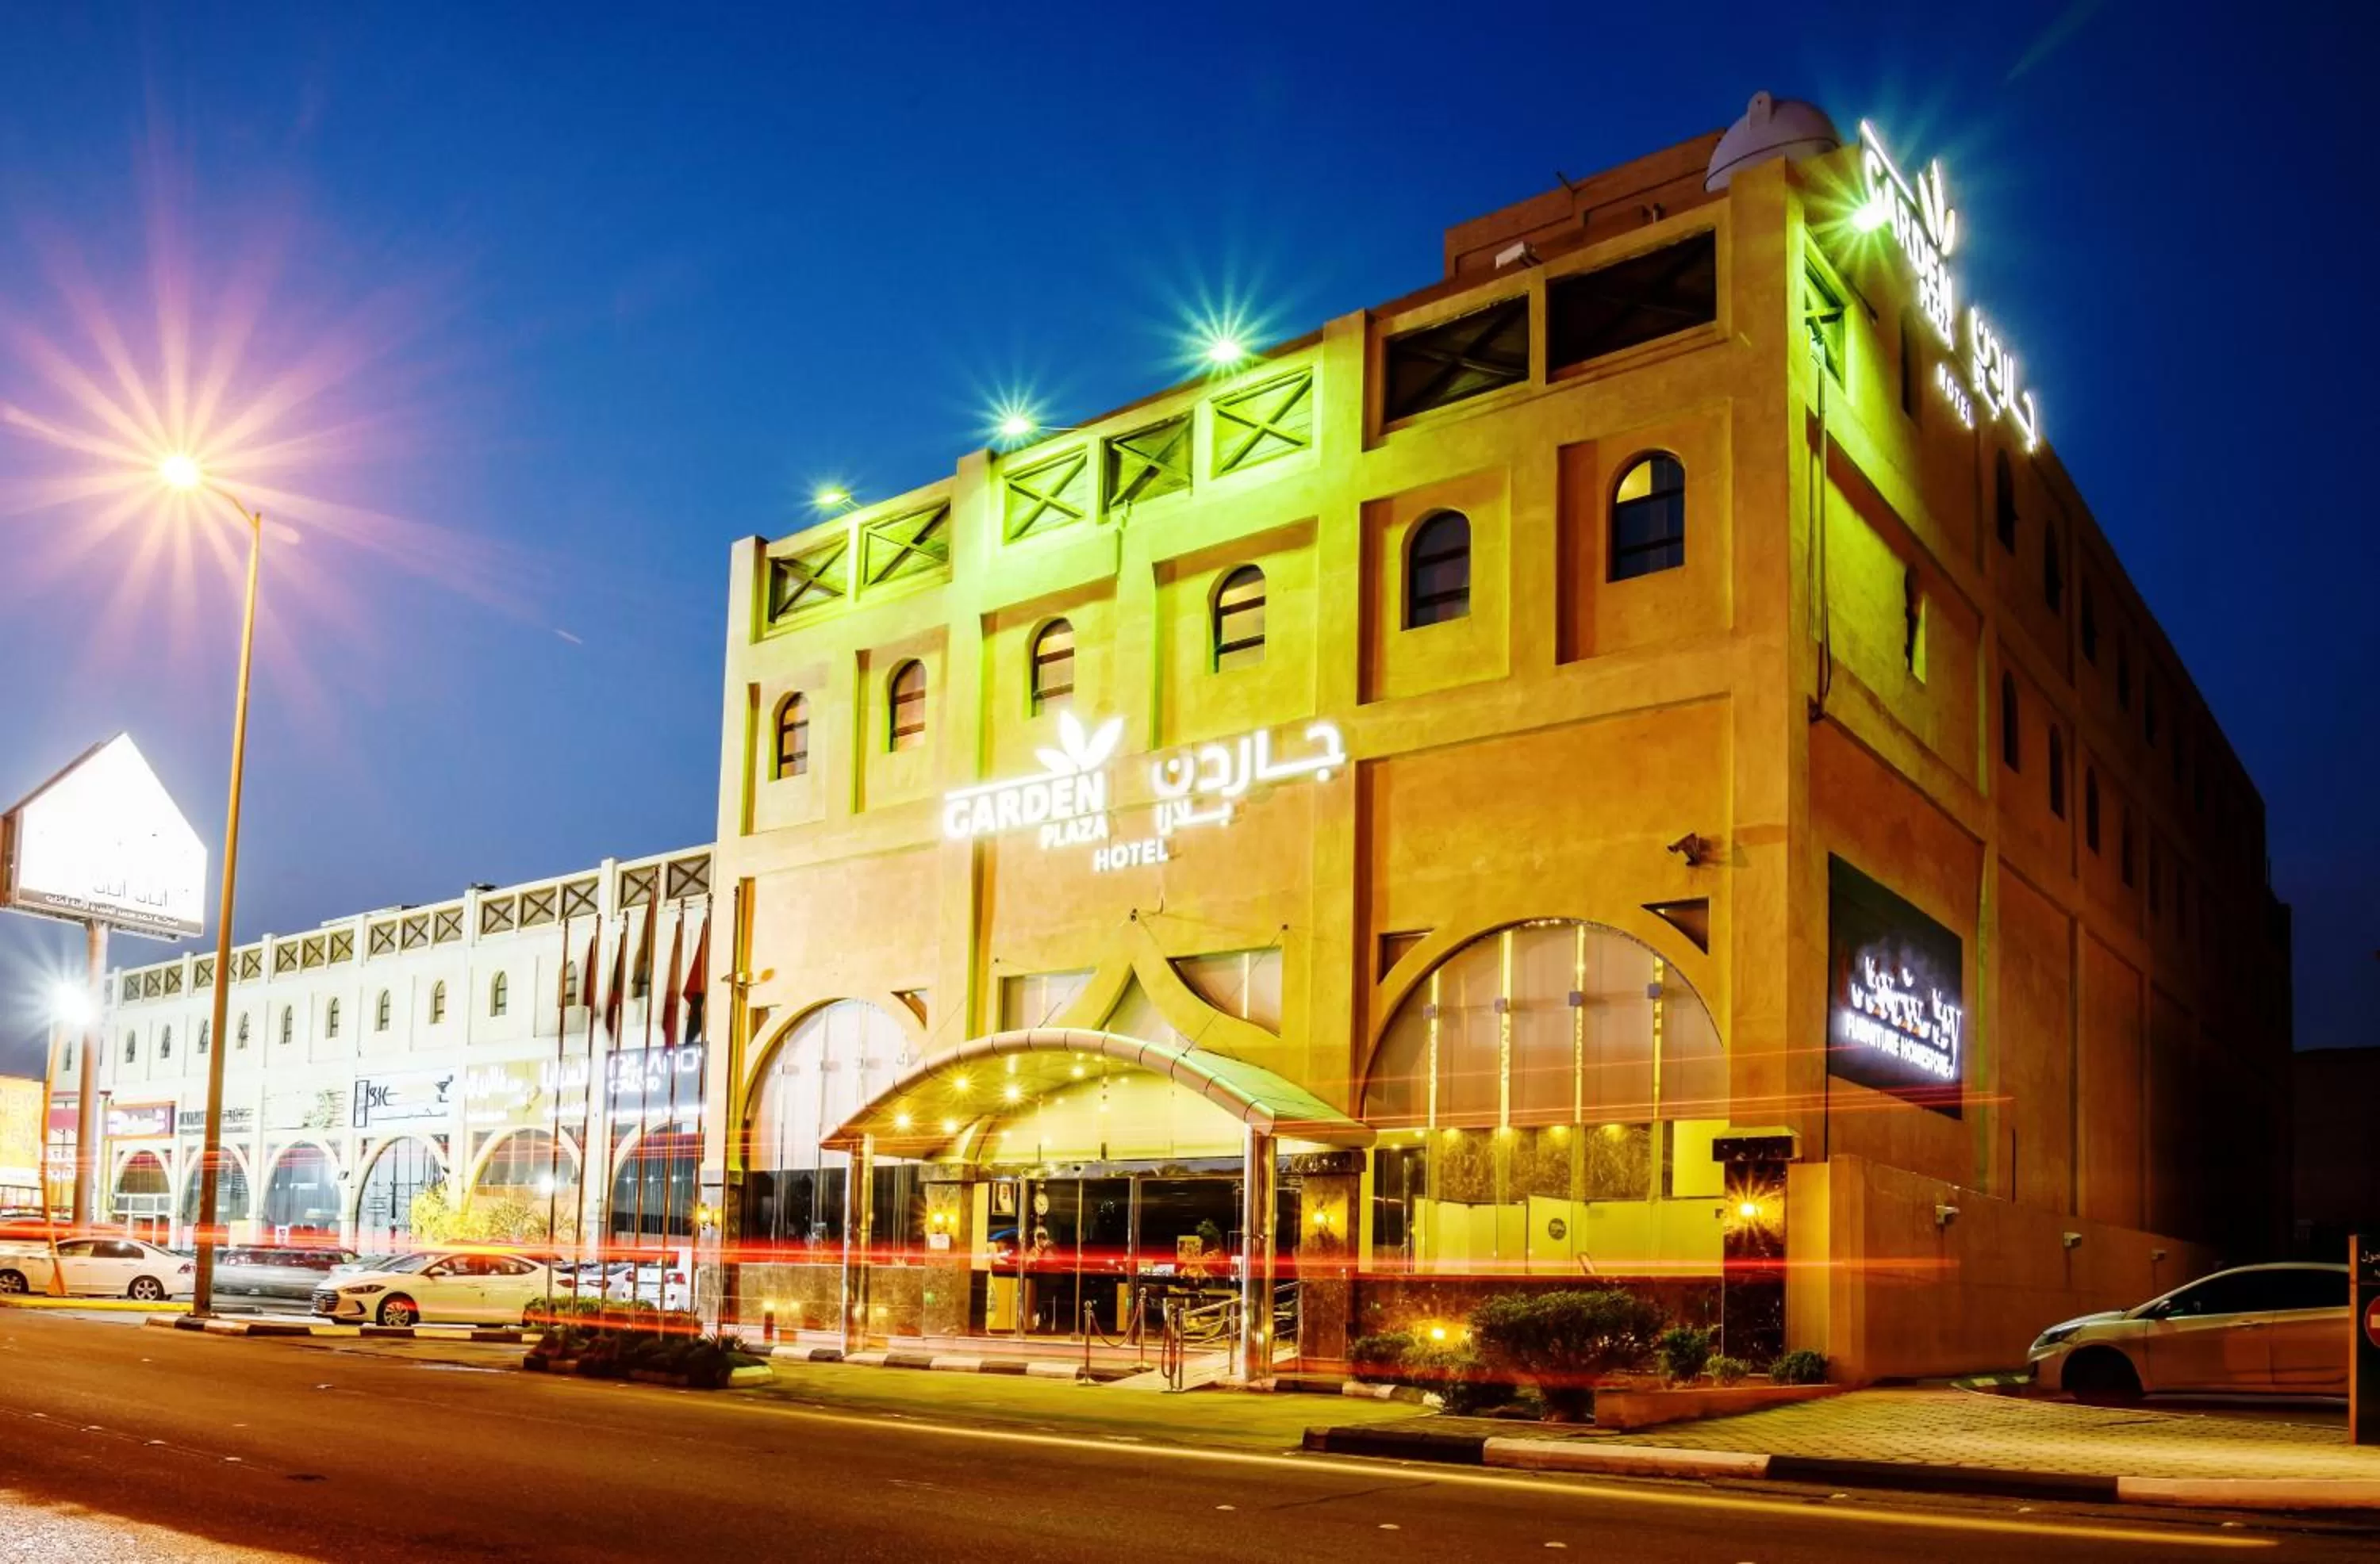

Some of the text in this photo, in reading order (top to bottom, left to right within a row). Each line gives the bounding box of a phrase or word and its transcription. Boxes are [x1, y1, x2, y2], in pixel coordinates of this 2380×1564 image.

[1864, 150, 1952, 305] GARDEN
[1937, 362, 1974, 430] HOTEL
[1151, 721, 1346, 797] جاردن
[942, 771, 1107, 839] GARDEN
[1039, 814, 1108, 850] PLAZA
[1093, 838, 1169, 873] HOTEL
